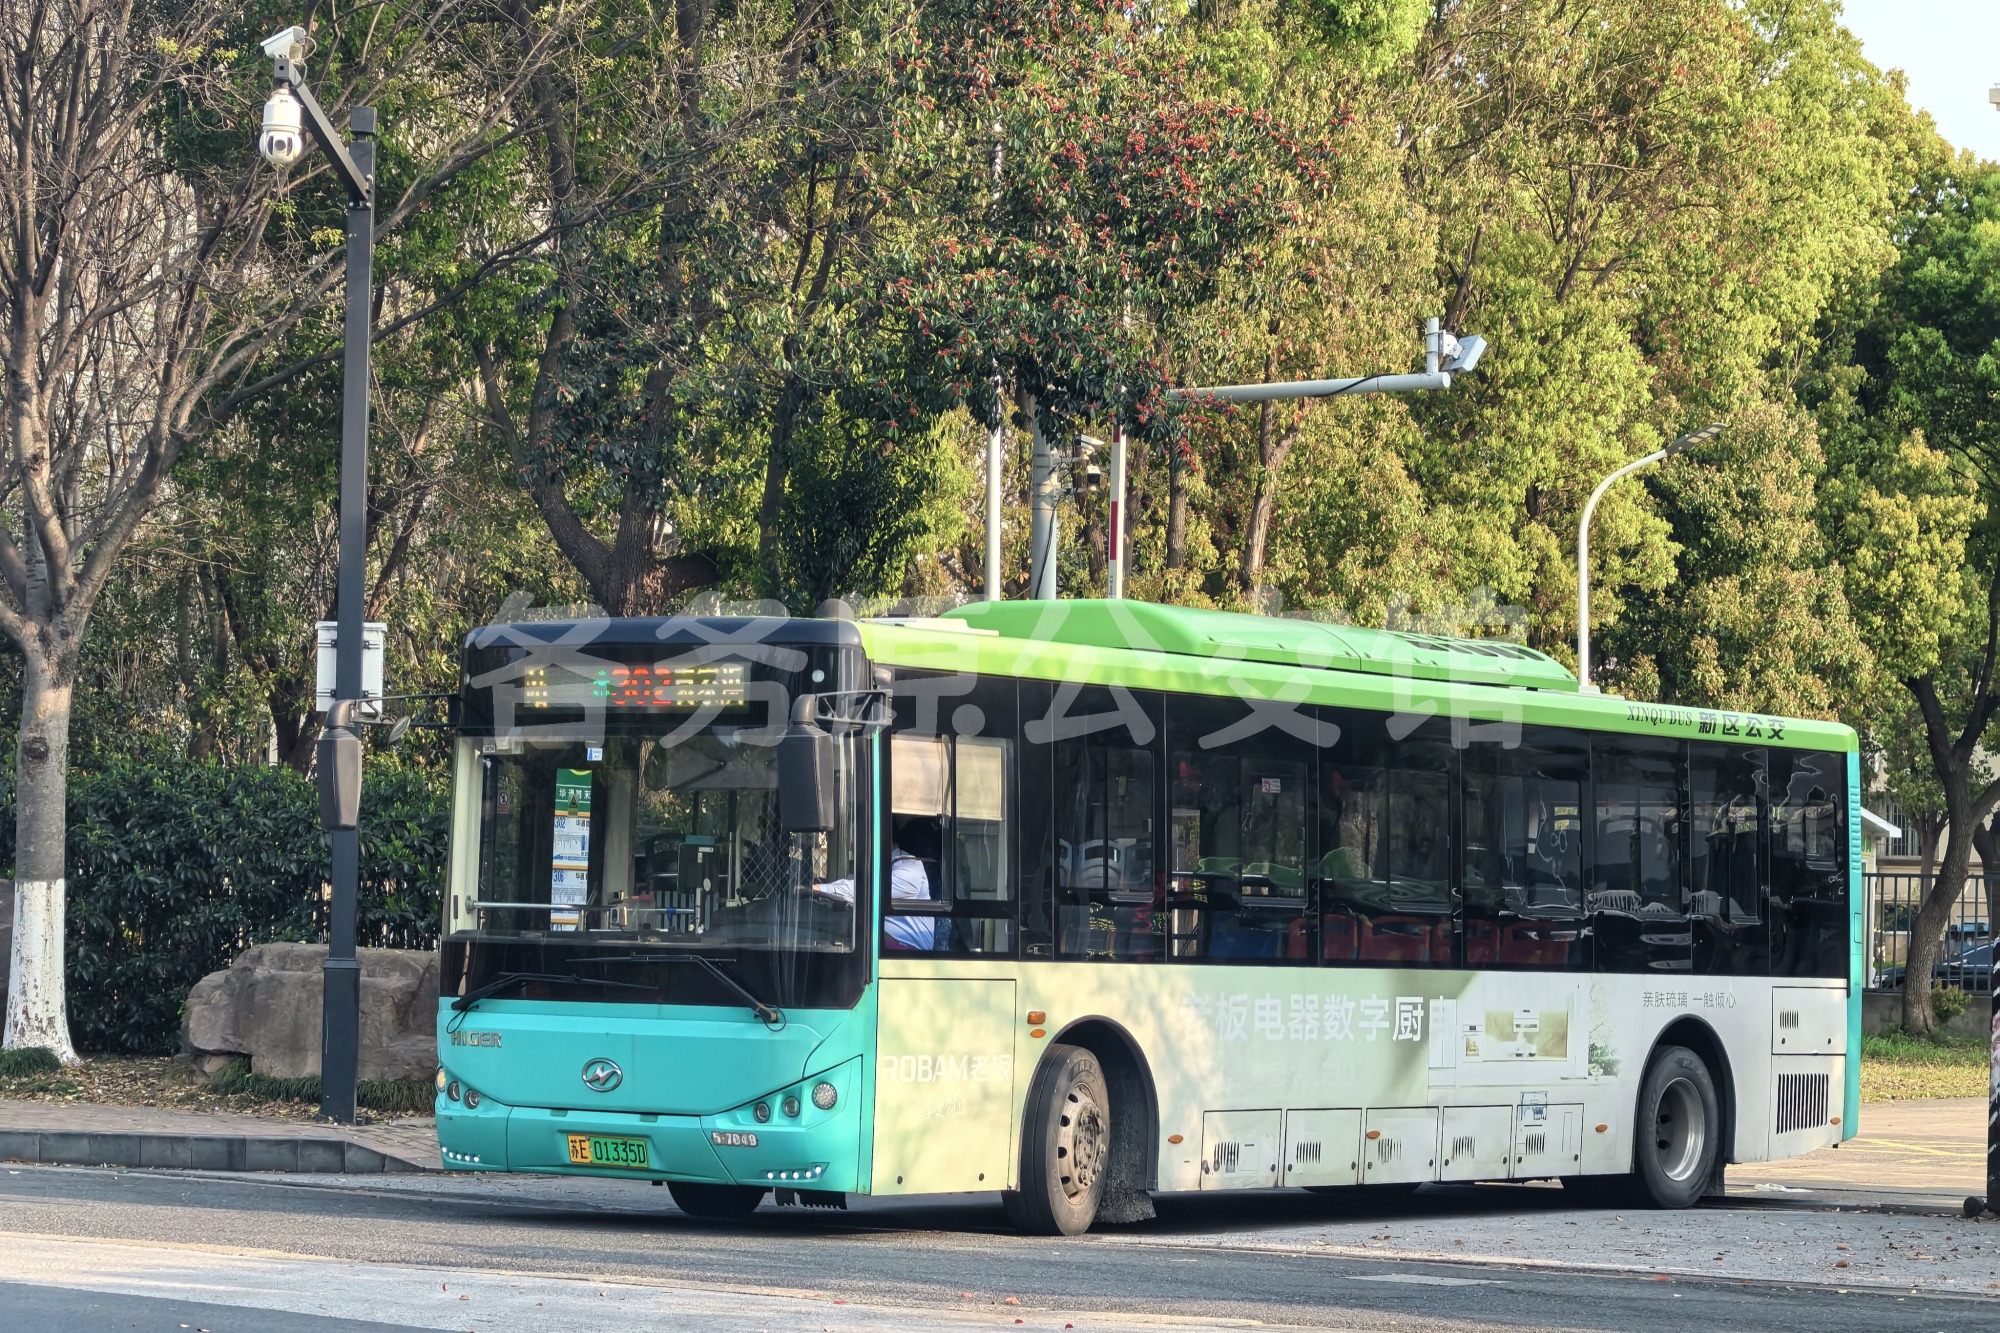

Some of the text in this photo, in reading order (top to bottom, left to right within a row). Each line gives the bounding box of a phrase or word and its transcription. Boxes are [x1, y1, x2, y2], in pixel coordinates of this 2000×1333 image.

[1627, 705, 1786, 741] XINQU BUS 新区公交
[1643, 991, 1737, 1009] 亲肤琉璃 一触倾心
[451, 1030, 502, 1048] HIGER
